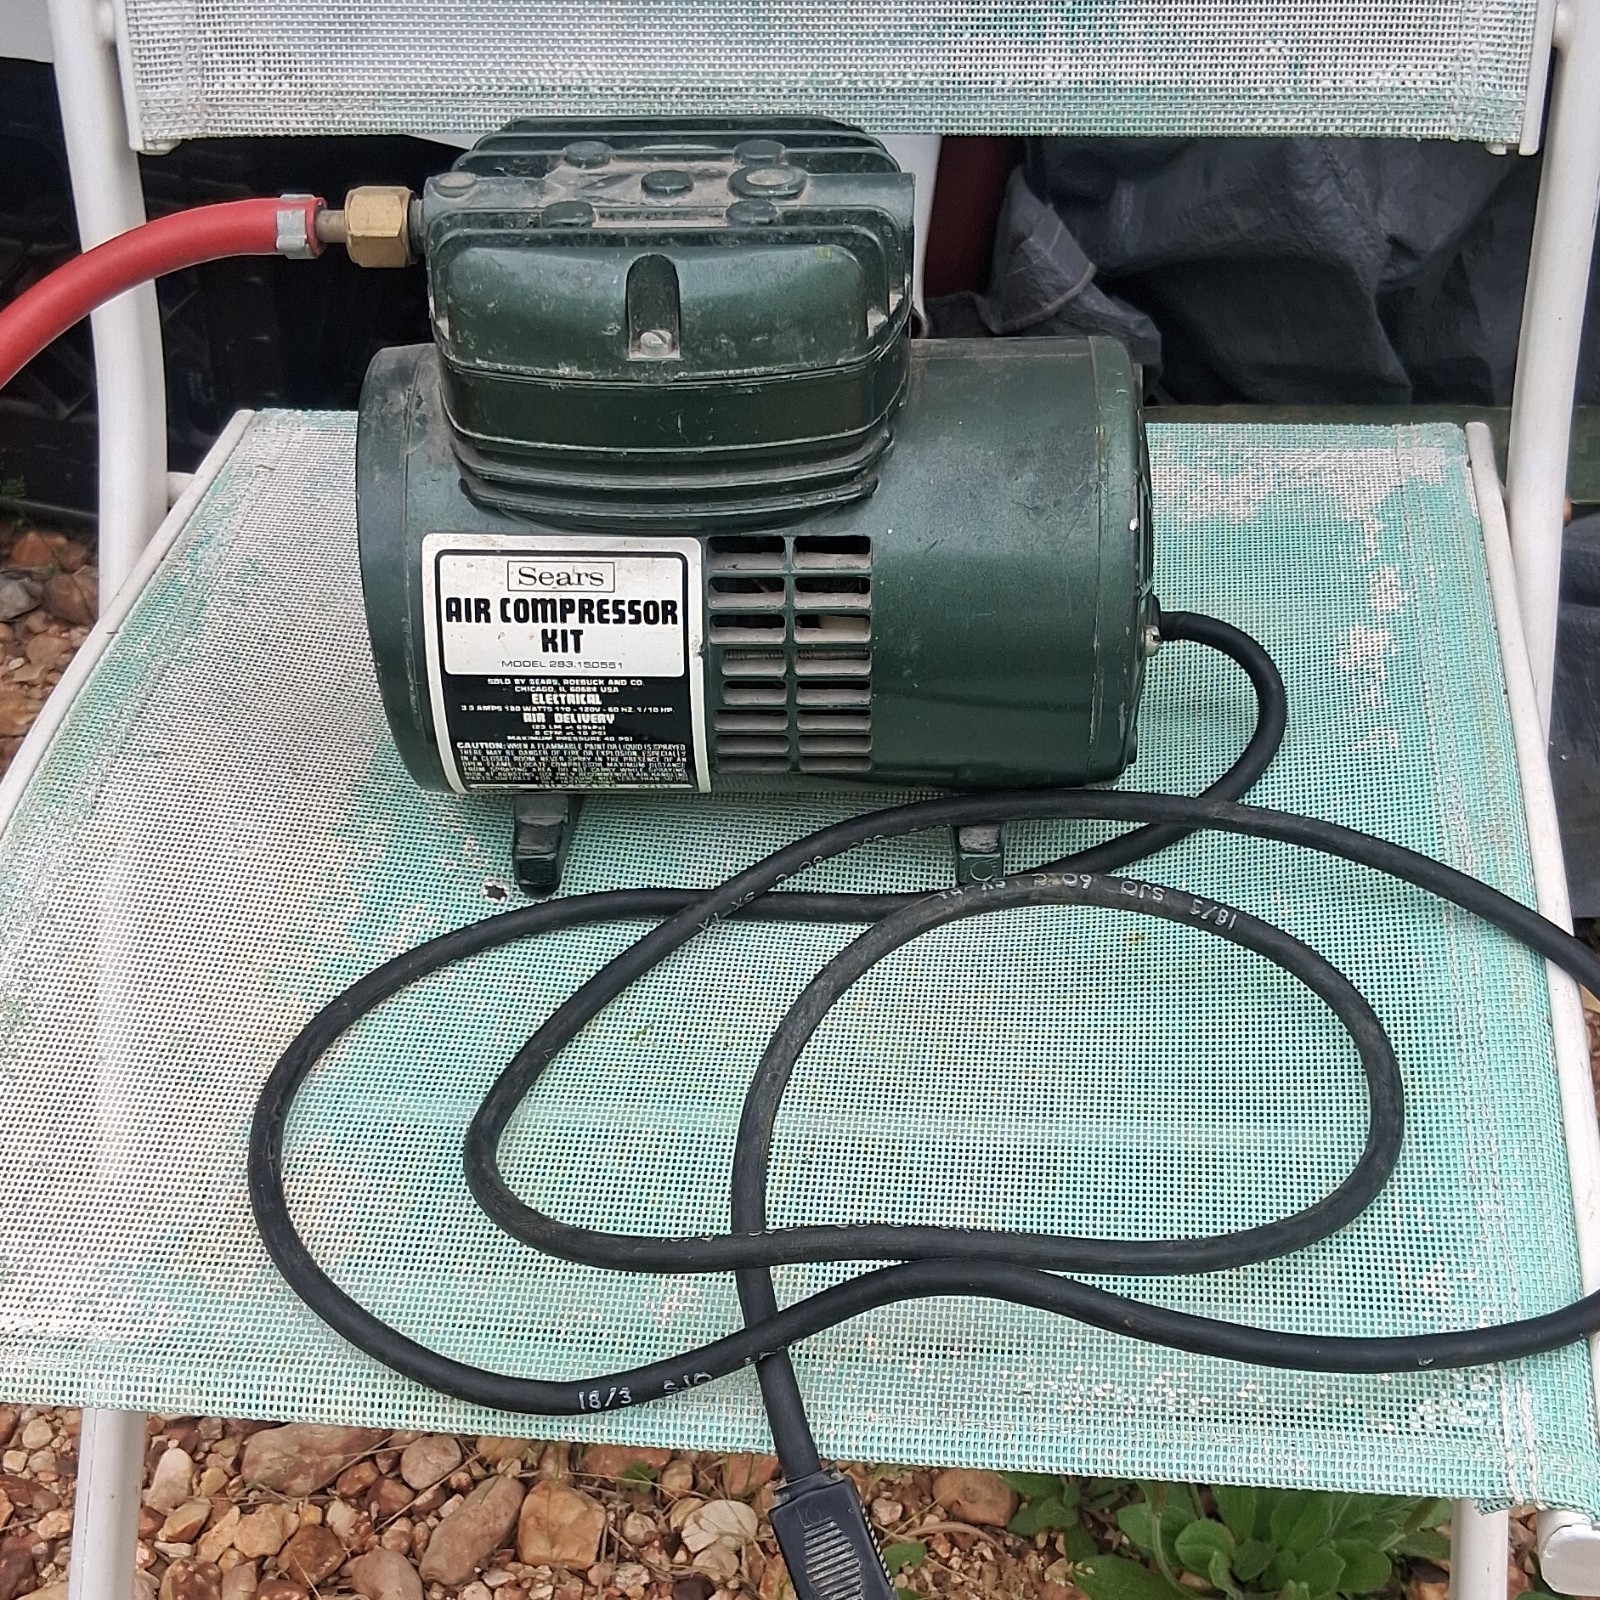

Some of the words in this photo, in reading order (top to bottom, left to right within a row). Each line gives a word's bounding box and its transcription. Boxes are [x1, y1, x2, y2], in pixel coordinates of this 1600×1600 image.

[517, 566, 605, 586] Sears
[445, 597, 491, 623] AIR
[500, 597, 678, 625] COMPRESSOR
[541, 629, 584, 654] KIT
[501, 660, 546, 668] MODEL
[531, 693, 602, 705] ELECTRICAL
[523, 713, 546, 722] AIR
[554, 714, 615, 724] DELIVERY
[1188, 898, 1237, 931] 18/3
[578, 1386, 633, 1411] 18/3
